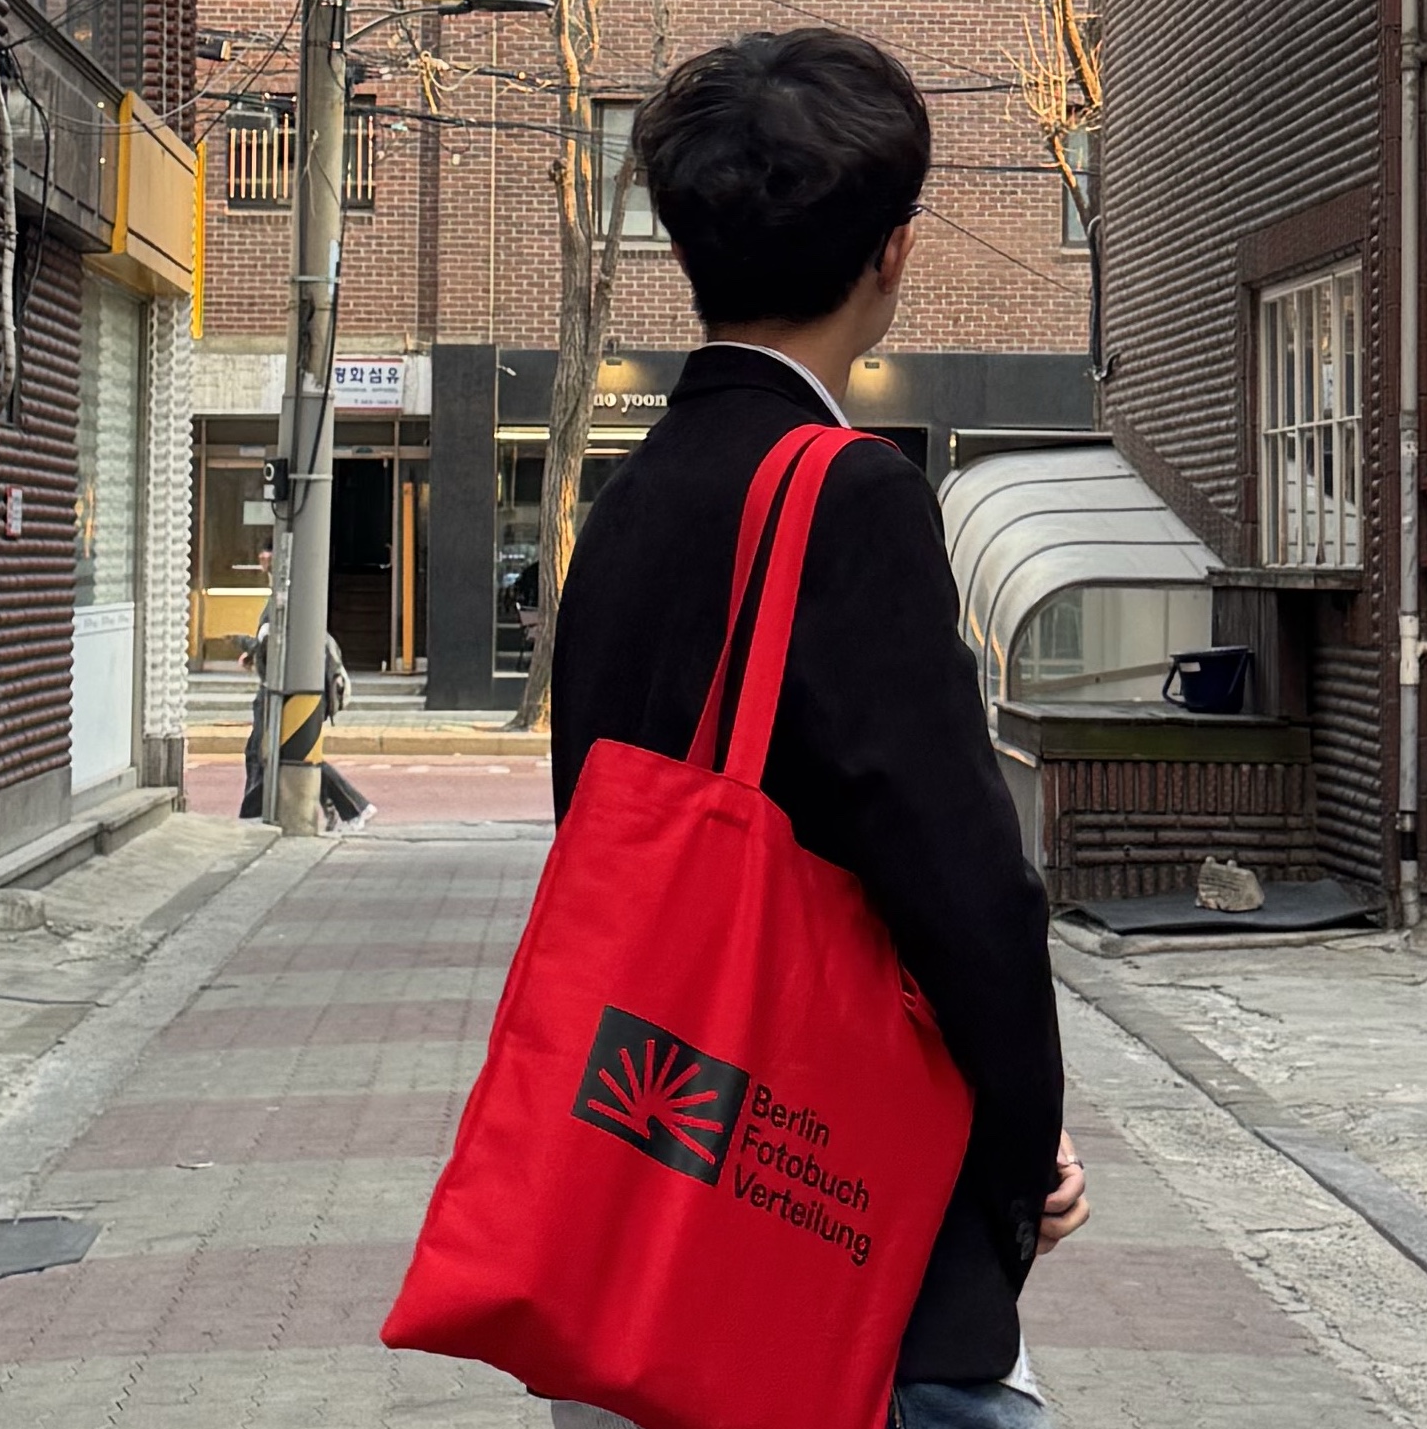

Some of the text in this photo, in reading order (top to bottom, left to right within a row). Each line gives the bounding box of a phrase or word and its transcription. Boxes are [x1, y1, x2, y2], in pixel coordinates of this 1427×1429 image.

[334, 367, 400, 384] 평화섬유
[621, 393, 668, 413] yoon
[750, 1083, 830, 1148] Berlin
[740, 1124, 870, 1213] Fotobuch
[733, 1163, 872, 1267] Verteilung
